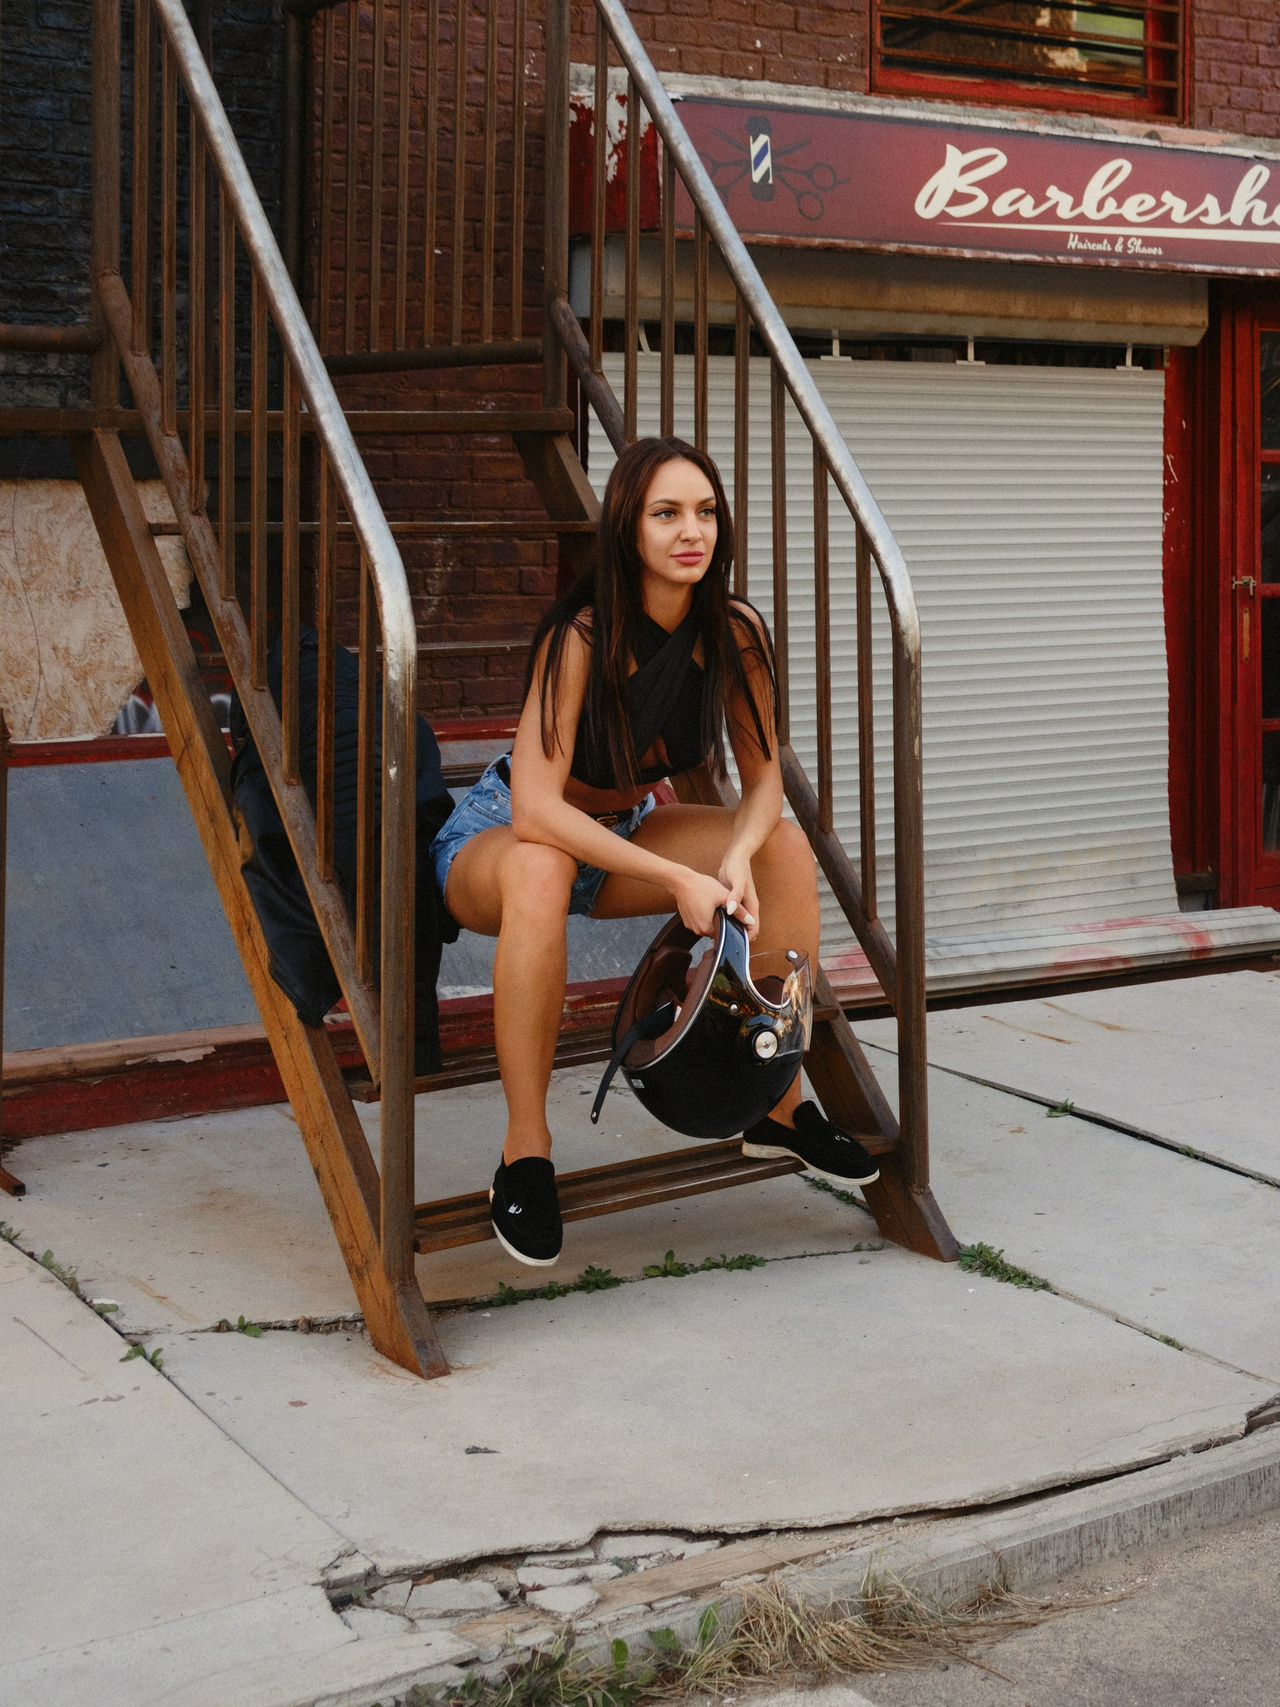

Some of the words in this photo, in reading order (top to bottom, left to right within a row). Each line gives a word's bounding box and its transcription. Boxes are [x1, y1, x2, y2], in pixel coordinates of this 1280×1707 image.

[1067, 232, 1112, 251] Haircuts
[1115, 236, 1124, 253] &
[1127, 237, 1163, 255] Shaves
